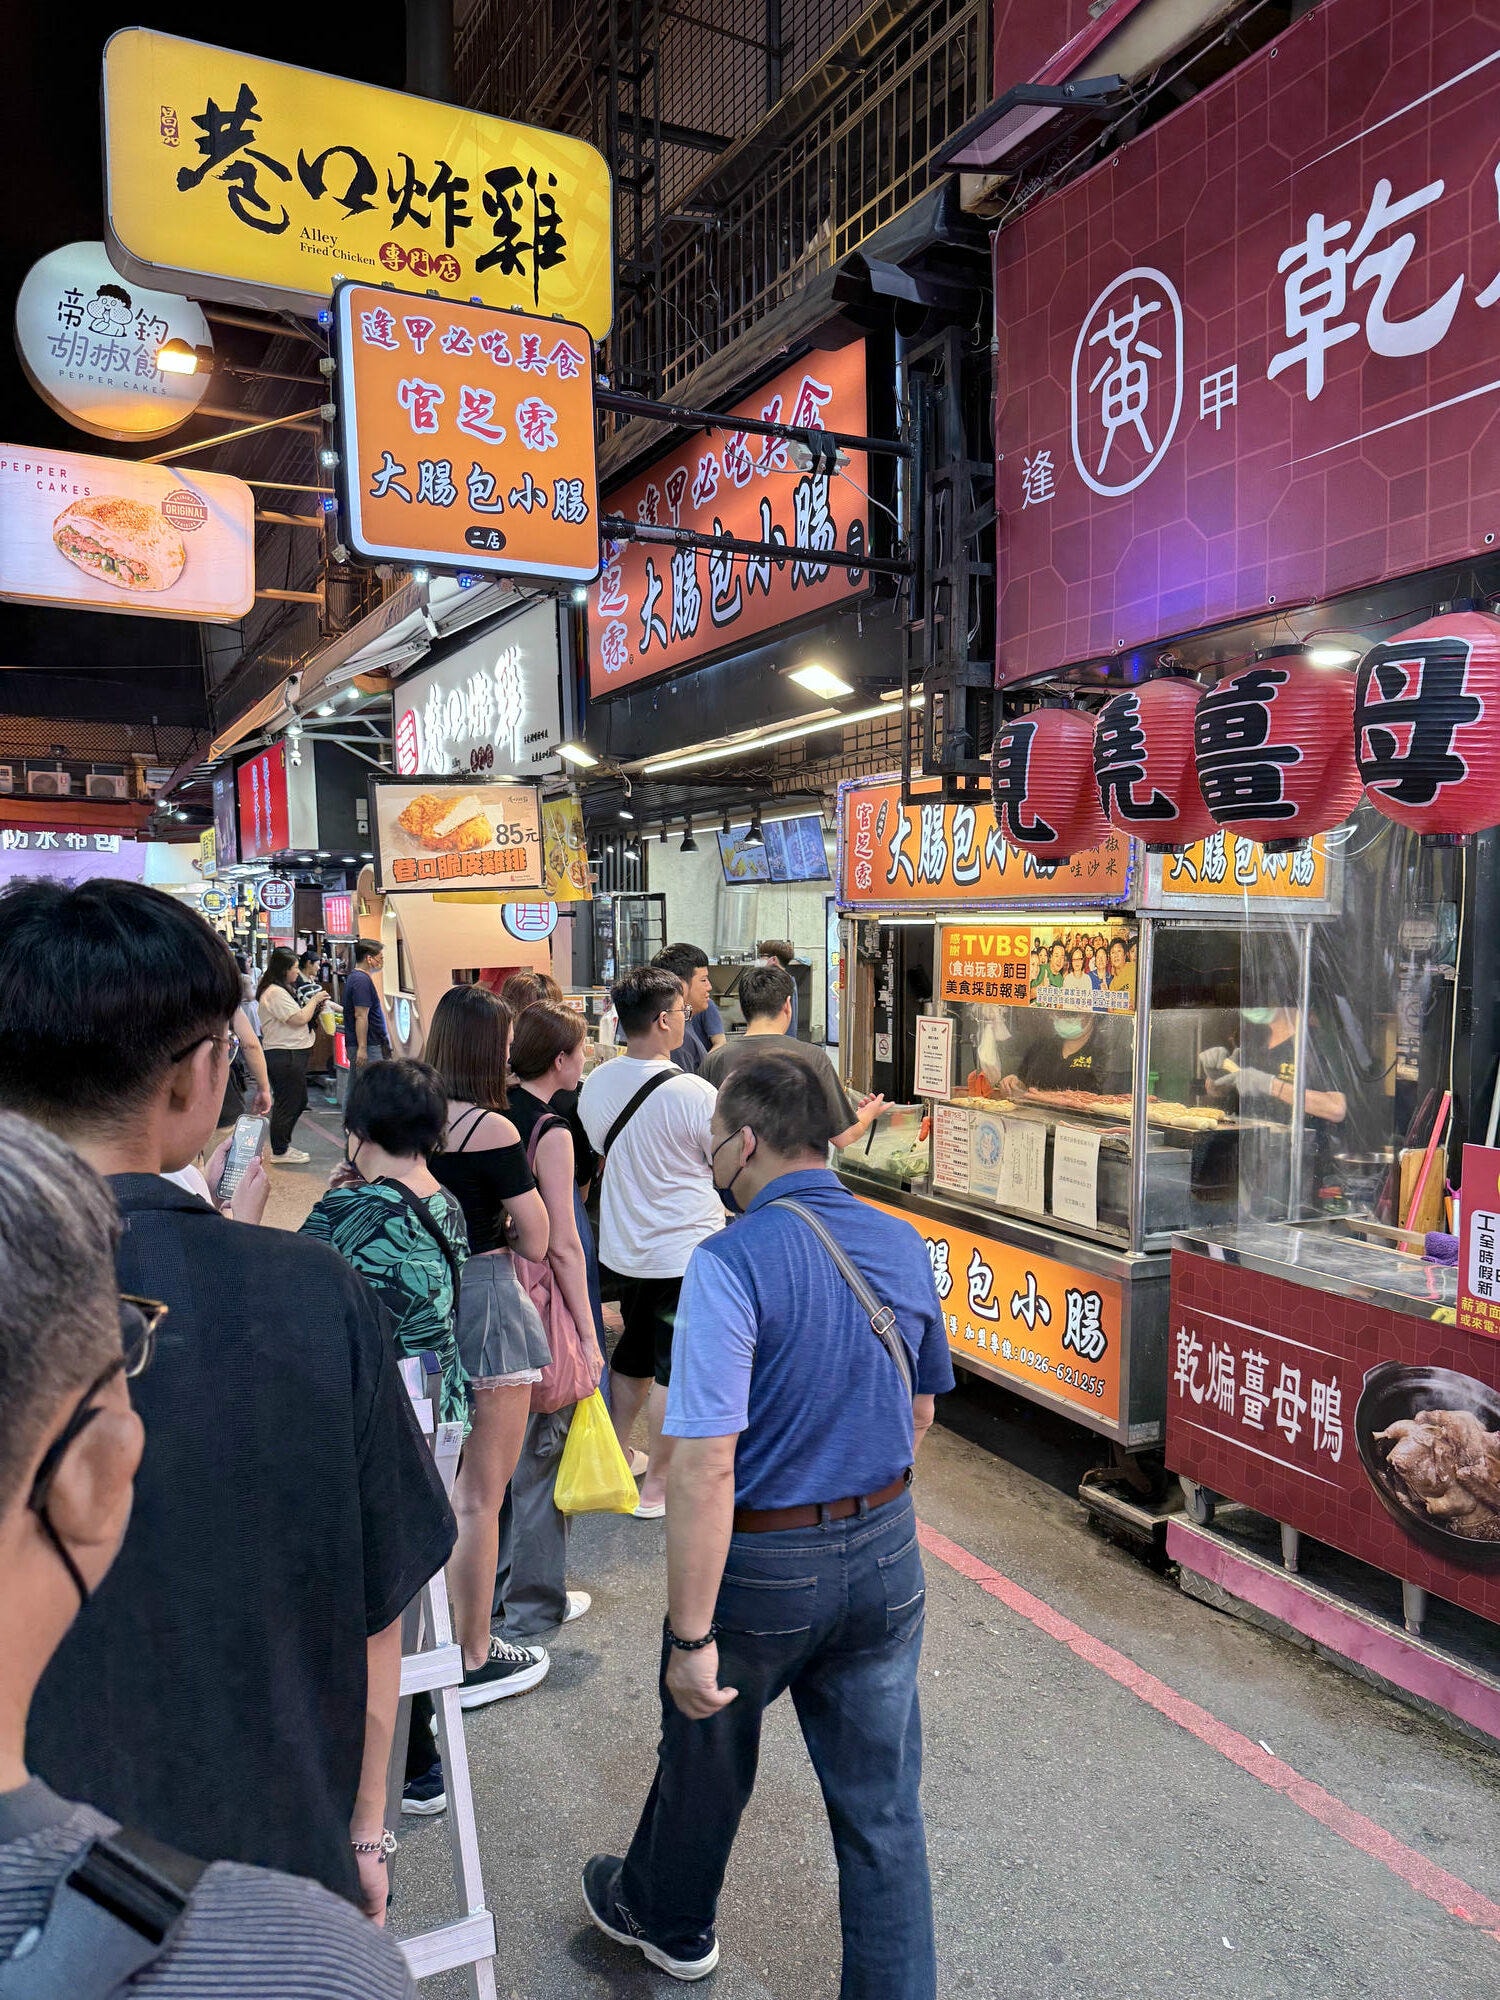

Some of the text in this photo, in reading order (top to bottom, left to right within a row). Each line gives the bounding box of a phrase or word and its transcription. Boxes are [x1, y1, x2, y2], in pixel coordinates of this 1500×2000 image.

[177, 83, 568, 306] 巷口炸雞
[299, 226, 338, 248] Alley
[300, 241, 376, 266] Fried Chicken
[379, 242, 461, 282] 專門店
[1268, 157, 1500, 402] 乾
[360, 305, 586, 379] 逢甲必吃美食
[58, 369, 167, 396] PEPPER CAKES
[400, 378, 559, 452] 官芝霖
[1021, 449, 1056, 511] 逢
[1199, 363, 1238, 431] 甲
[0, 460, 68, 479] PEPPER
[36, 480, 91, 497] CAKES
[369, 450, 590, 524] 大腸包小腸
[165, 504, 205, 519] ORIGINAL
[470, 531, 501, 550] 二店
[1, 829, 122, 853] 防水布包
[495, 821, 541, 847] 85元
[854, 802, 874, 890] 官芝霖
[1069, 858, 1119, 878] 哇沙米
[963, 934, 1030, 958] TVBS
[945, 980, 1028, 999] 美食採訪報導
[1459, 1313, 1500, 1334] 或來電:
[1173, 1325, 1344, 1463] 乾煸薑母鴨
